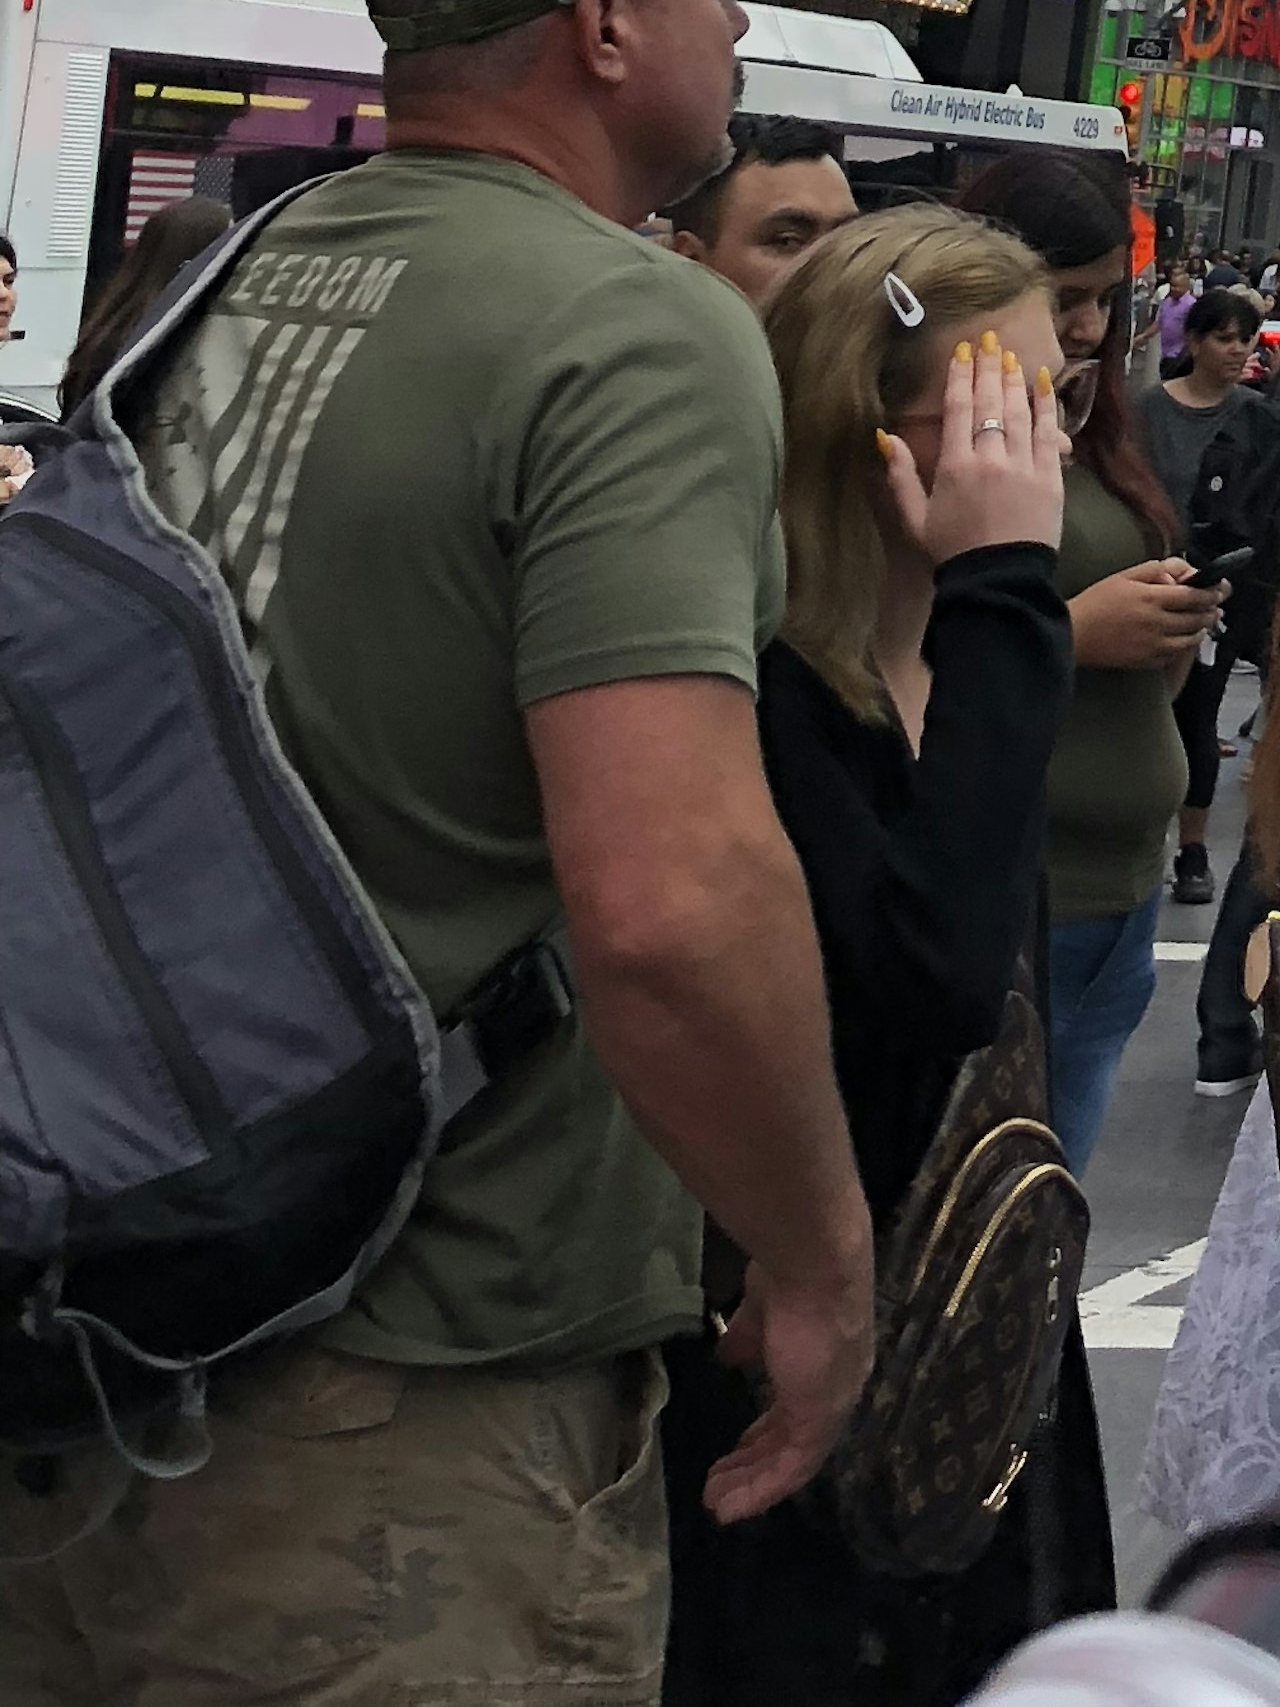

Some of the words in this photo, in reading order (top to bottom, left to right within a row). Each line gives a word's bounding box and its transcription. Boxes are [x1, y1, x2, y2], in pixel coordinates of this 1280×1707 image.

[891, 90, 921, 114] Clean
[924, 94, 942, 116] Air
[945, 95, 981, 124] Hybrid
[983, 101, 1022, 127] Electric
[1025, 107, 1045, 129] Bus
[1073, 116, 1099, 139] 4229
